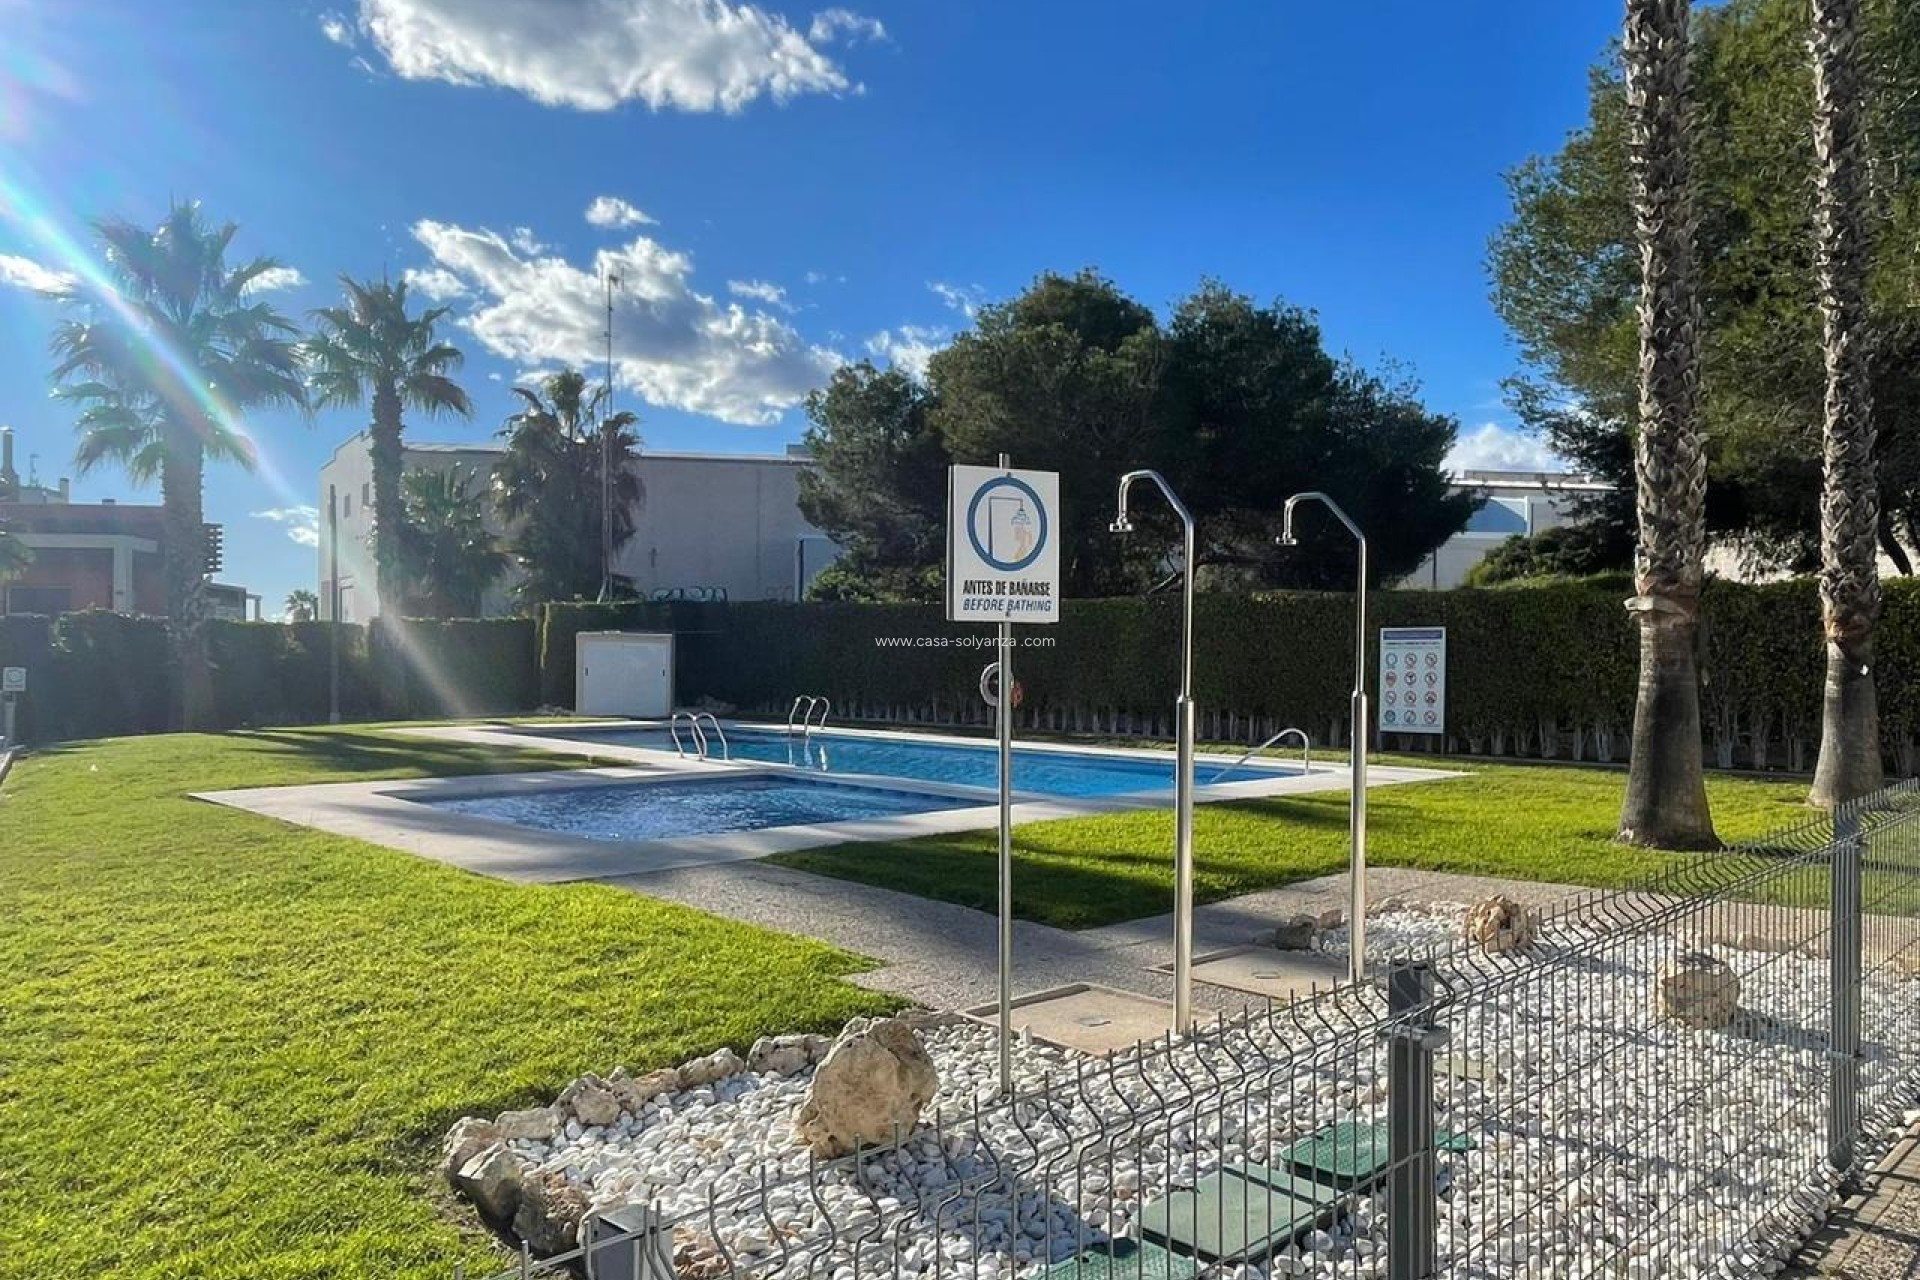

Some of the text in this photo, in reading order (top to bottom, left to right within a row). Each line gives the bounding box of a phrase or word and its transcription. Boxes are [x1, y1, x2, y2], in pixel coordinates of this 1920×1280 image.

[963, 578, 1050, 596] ANTES DE BAÑARSE
[963, 598, 1052, 612] BEFORE BATHING
